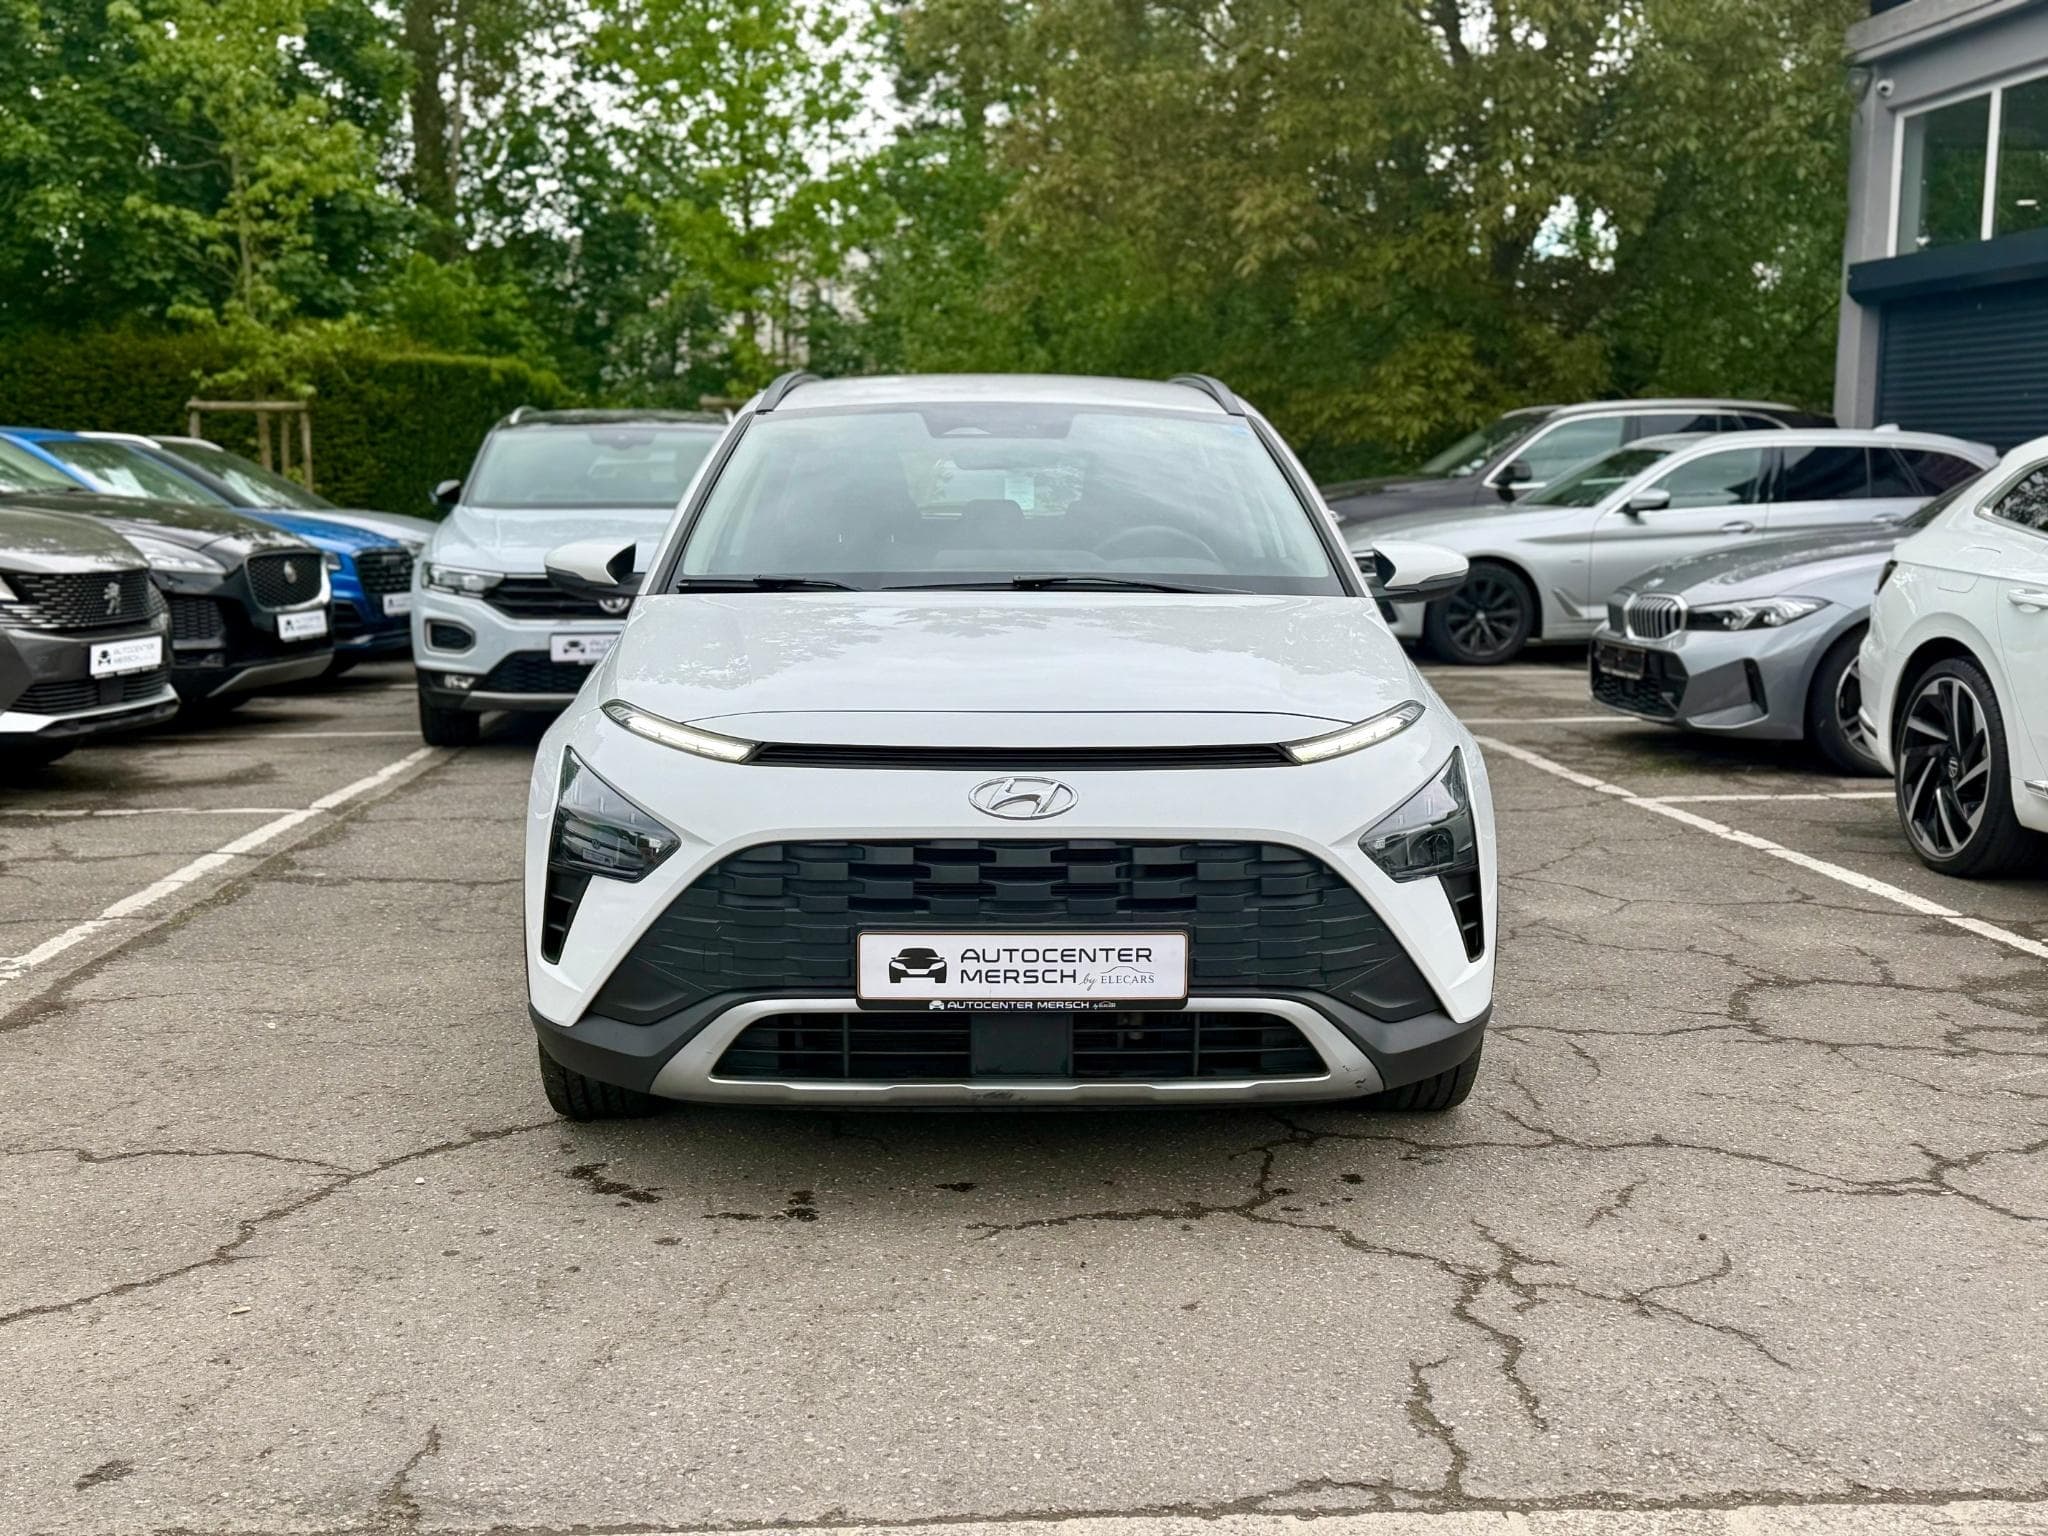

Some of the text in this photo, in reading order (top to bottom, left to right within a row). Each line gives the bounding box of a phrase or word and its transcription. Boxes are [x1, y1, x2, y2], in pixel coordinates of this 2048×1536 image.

[960, 947, 1153, 963] AUTOCENTER
[960, 968, 1155, 991] MERSCH by ELECARS
[947, 1001, 1033, 1009] AUTOCENTER
[1037, 1001, 1090, 1009] MERSCH
